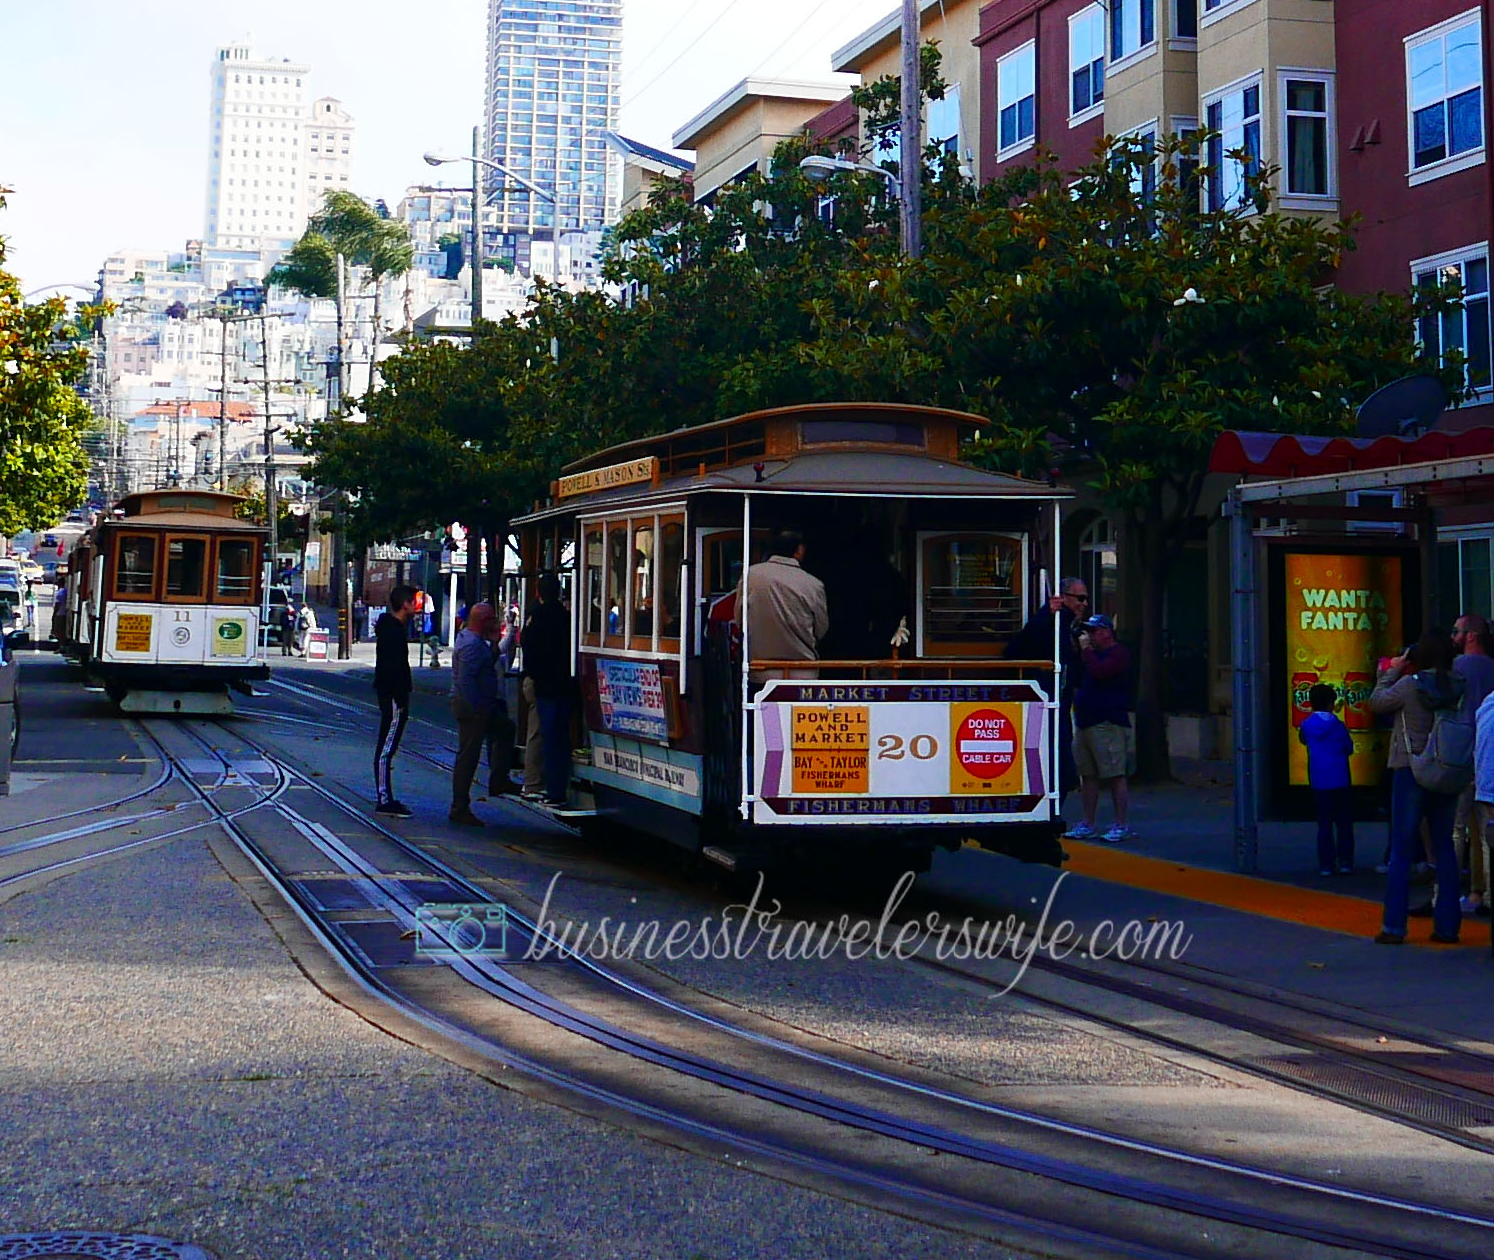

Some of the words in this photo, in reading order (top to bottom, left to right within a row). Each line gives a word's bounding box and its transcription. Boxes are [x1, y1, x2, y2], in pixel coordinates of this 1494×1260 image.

[561, 475, 592, 494] POWELL
[603, 465, 634, 485] MASON
[174, 611, 191, 622] 11
[800, 686, 889, 700] MARKET
[908, 686, 990, 700] STREET
[797, 712, 866, 723] POWELL
[815, 724, 849, 732] AND
[968, 719, 984, 729] DO
[985, 719, 1006, 729] NOT
[795, 733, 867, 744] MARKET
[974, 729, 1000, 739] PASS
[877, 734, 939, 760] 20
[794, 756, 813, 768] BAY
[830, 756, 867, 768] TAYLOR
[962, 754, 992, 764] CABLE
[993, 754, 1012, 764] CAR
[801, 771, 860, 780] FISHERMANS
[815, 780, 845, 789] WHARF
[786, 799, 932, 813] FISHERMANS
[955, 798, 1022, 813] WHARF
